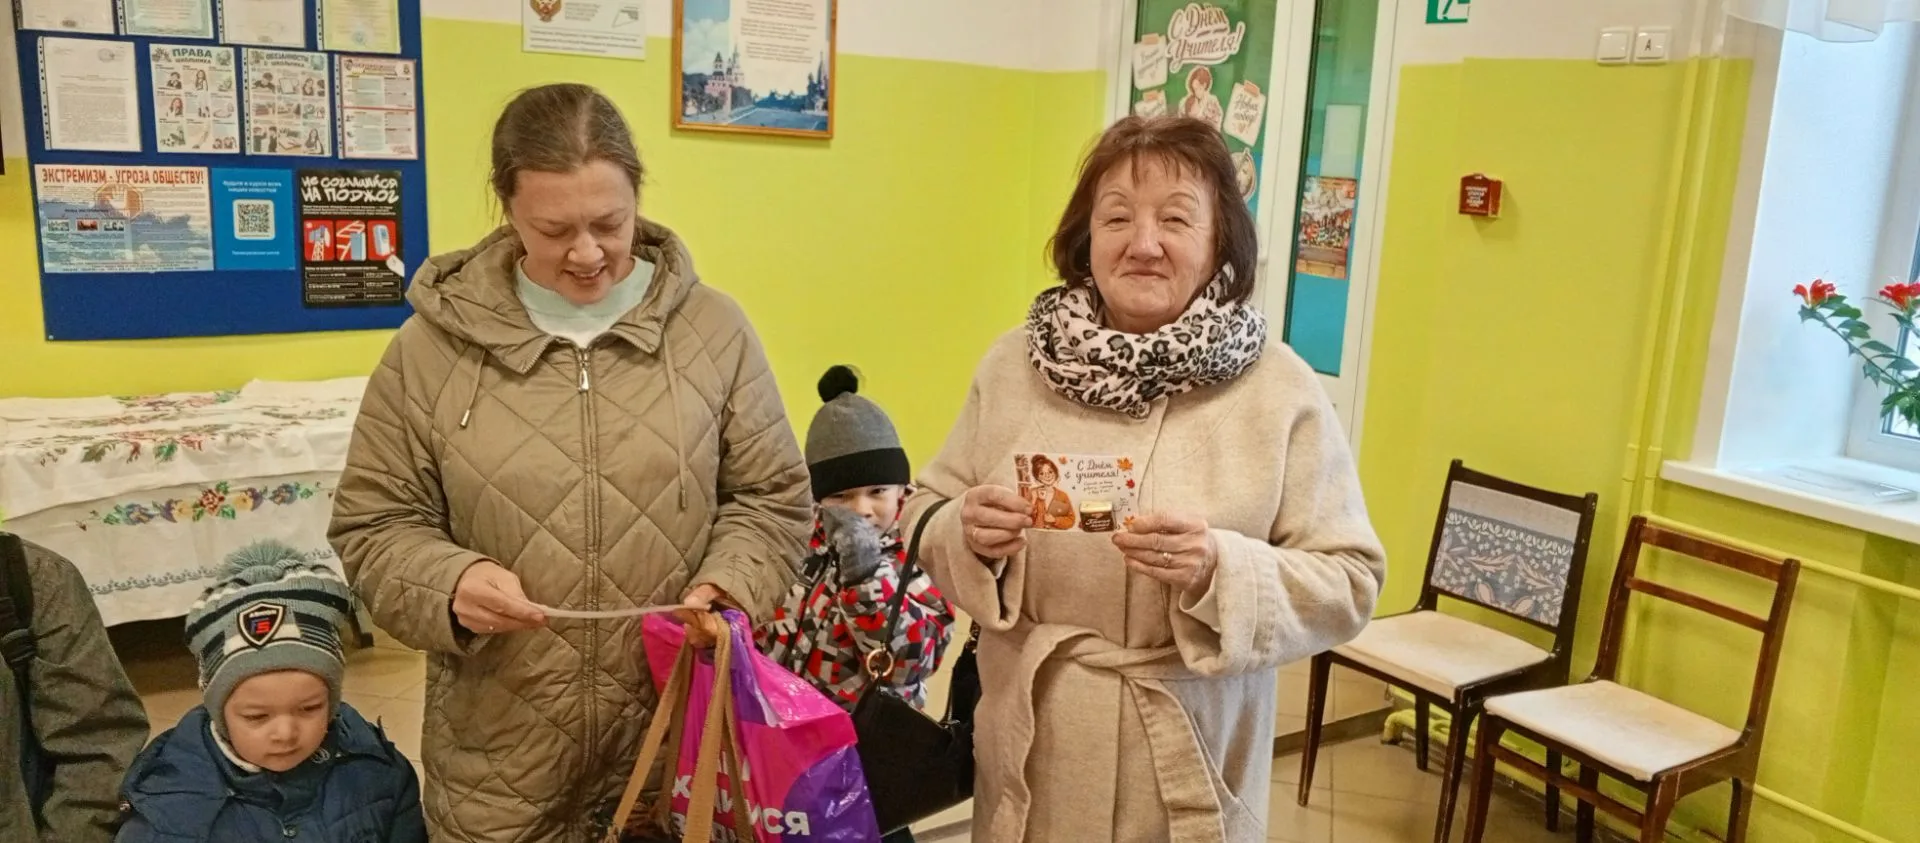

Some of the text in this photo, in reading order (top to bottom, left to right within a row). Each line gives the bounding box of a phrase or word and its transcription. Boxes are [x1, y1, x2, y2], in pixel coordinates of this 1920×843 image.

[1170, 12, 1184, 39] С
[172, 48, 212, 58] ПРАВА
[42, 168, 107, 184] ЭКСТРЕМИЗМ
[115, 170, 150, 184] УГРОЗА
[153, 171, 204, 187] ОБЩЕСТВУ!
[301, 187, 399, 204] НА ПОДЖОГ
[1077, 459, 1113, 471] С Днём
[1076, 469, 1119, 484] учителя!
